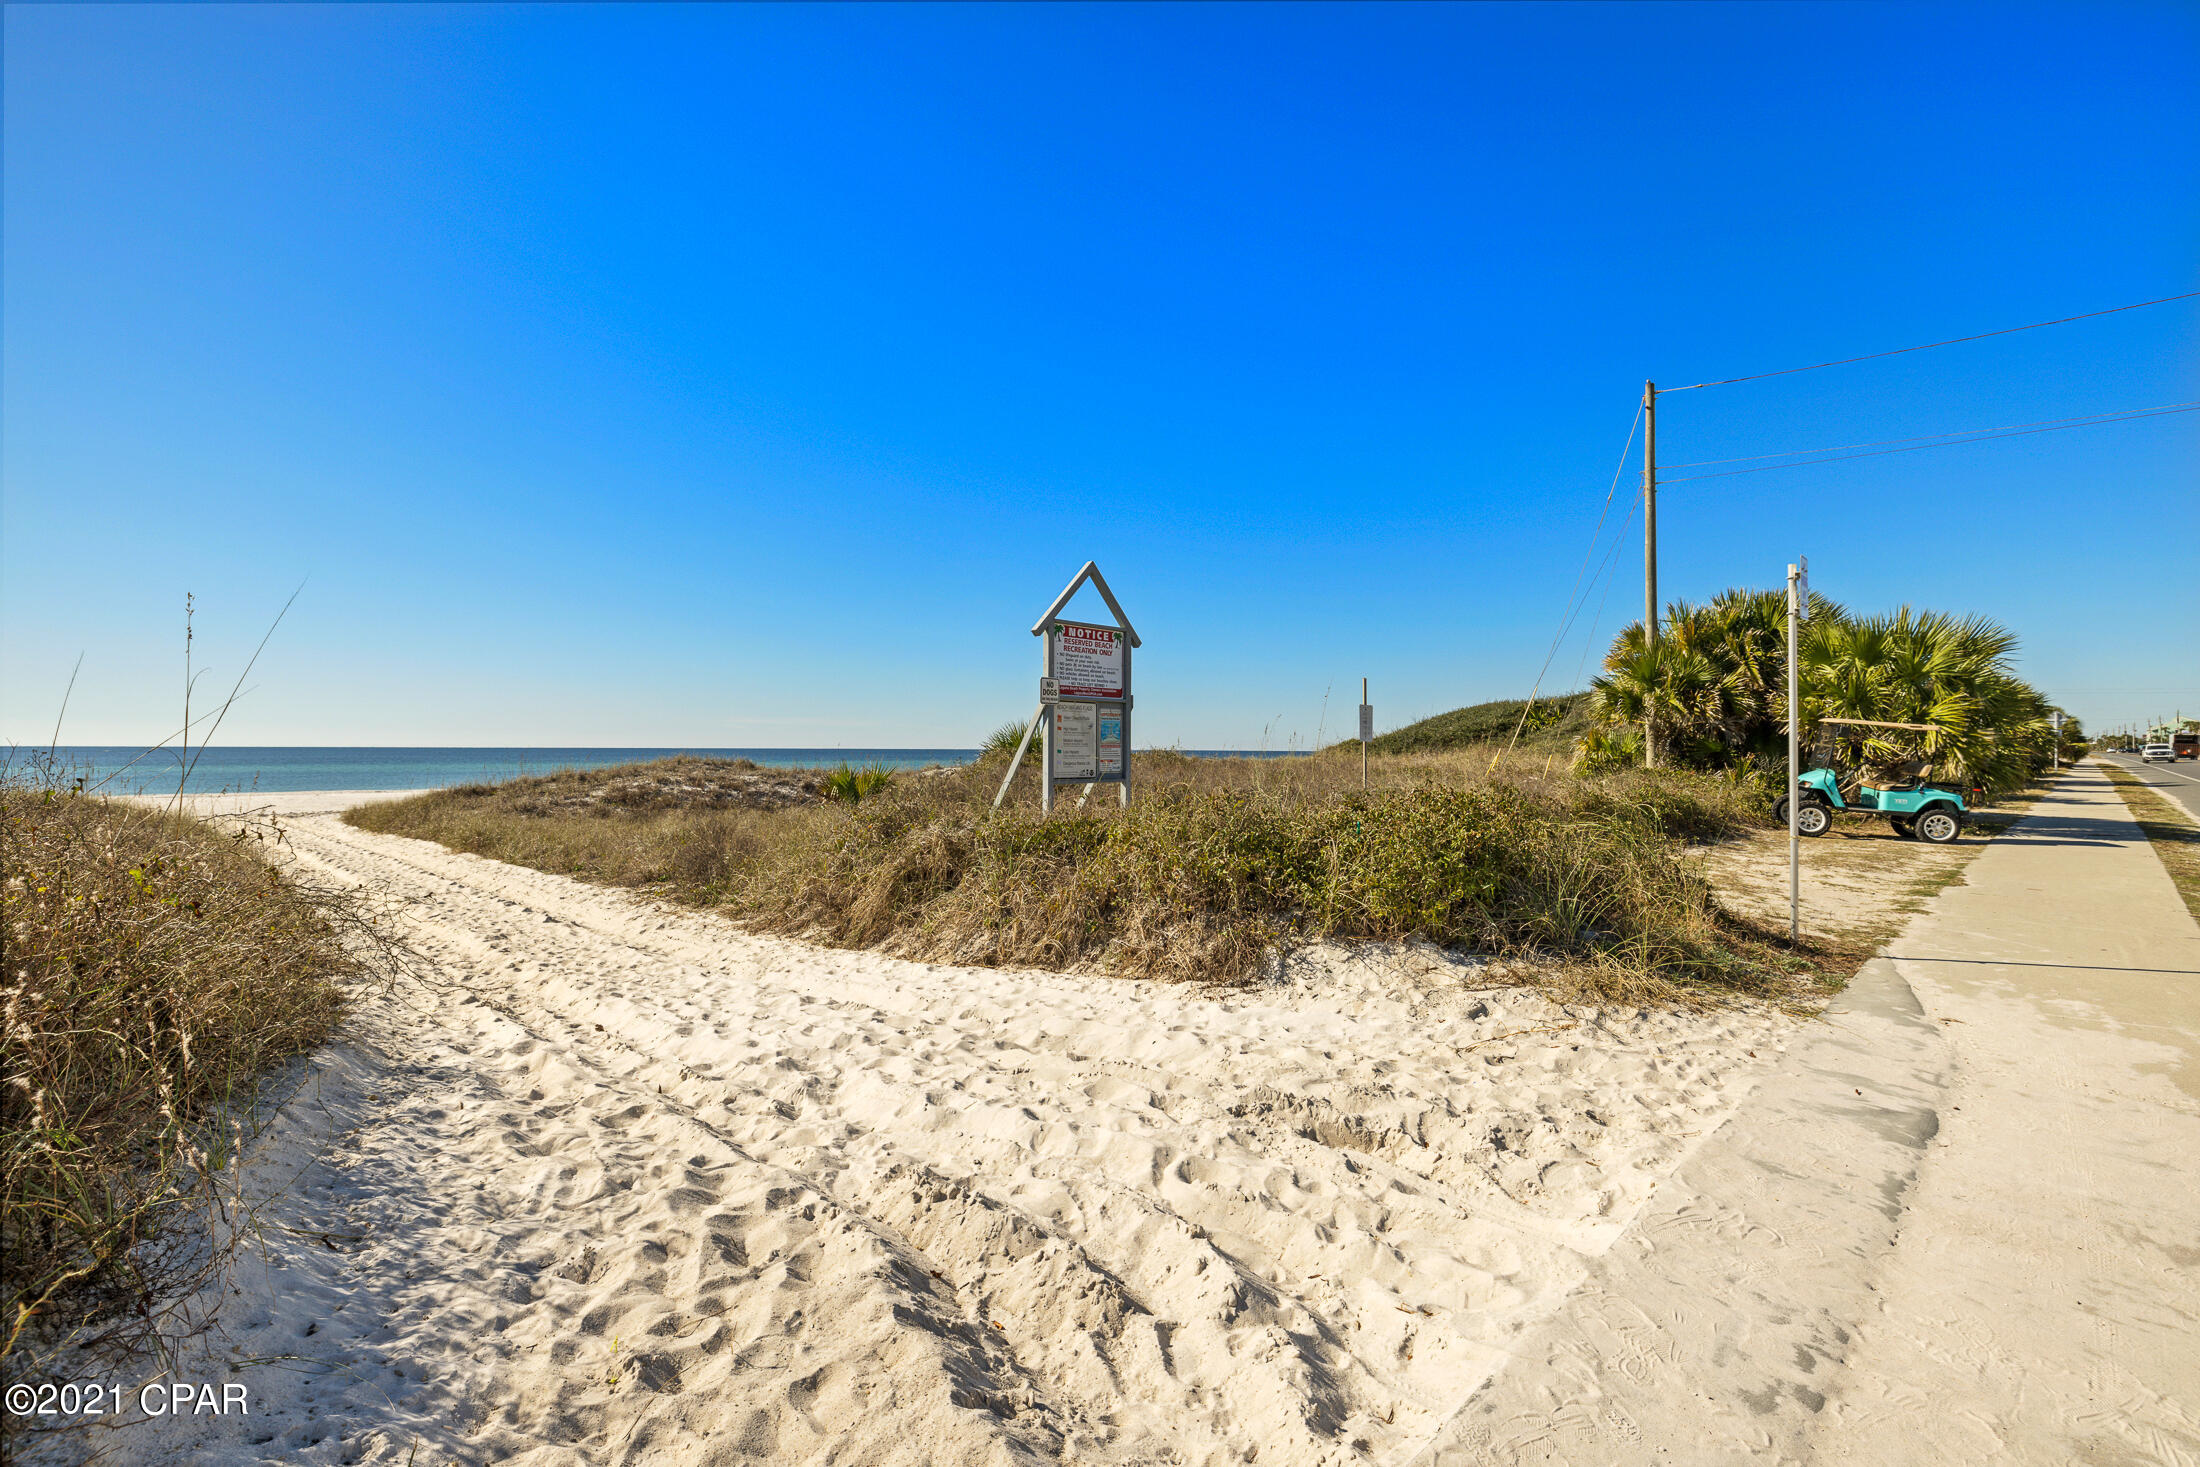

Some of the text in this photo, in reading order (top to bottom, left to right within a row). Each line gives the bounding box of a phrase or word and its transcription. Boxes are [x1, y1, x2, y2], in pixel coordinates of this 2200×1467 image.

[1069, 627, 1108, 641] NOTICE
[1064, 638, 1092, 646] RESERVED
[1064, 645, 1097, 654] RECREATION
